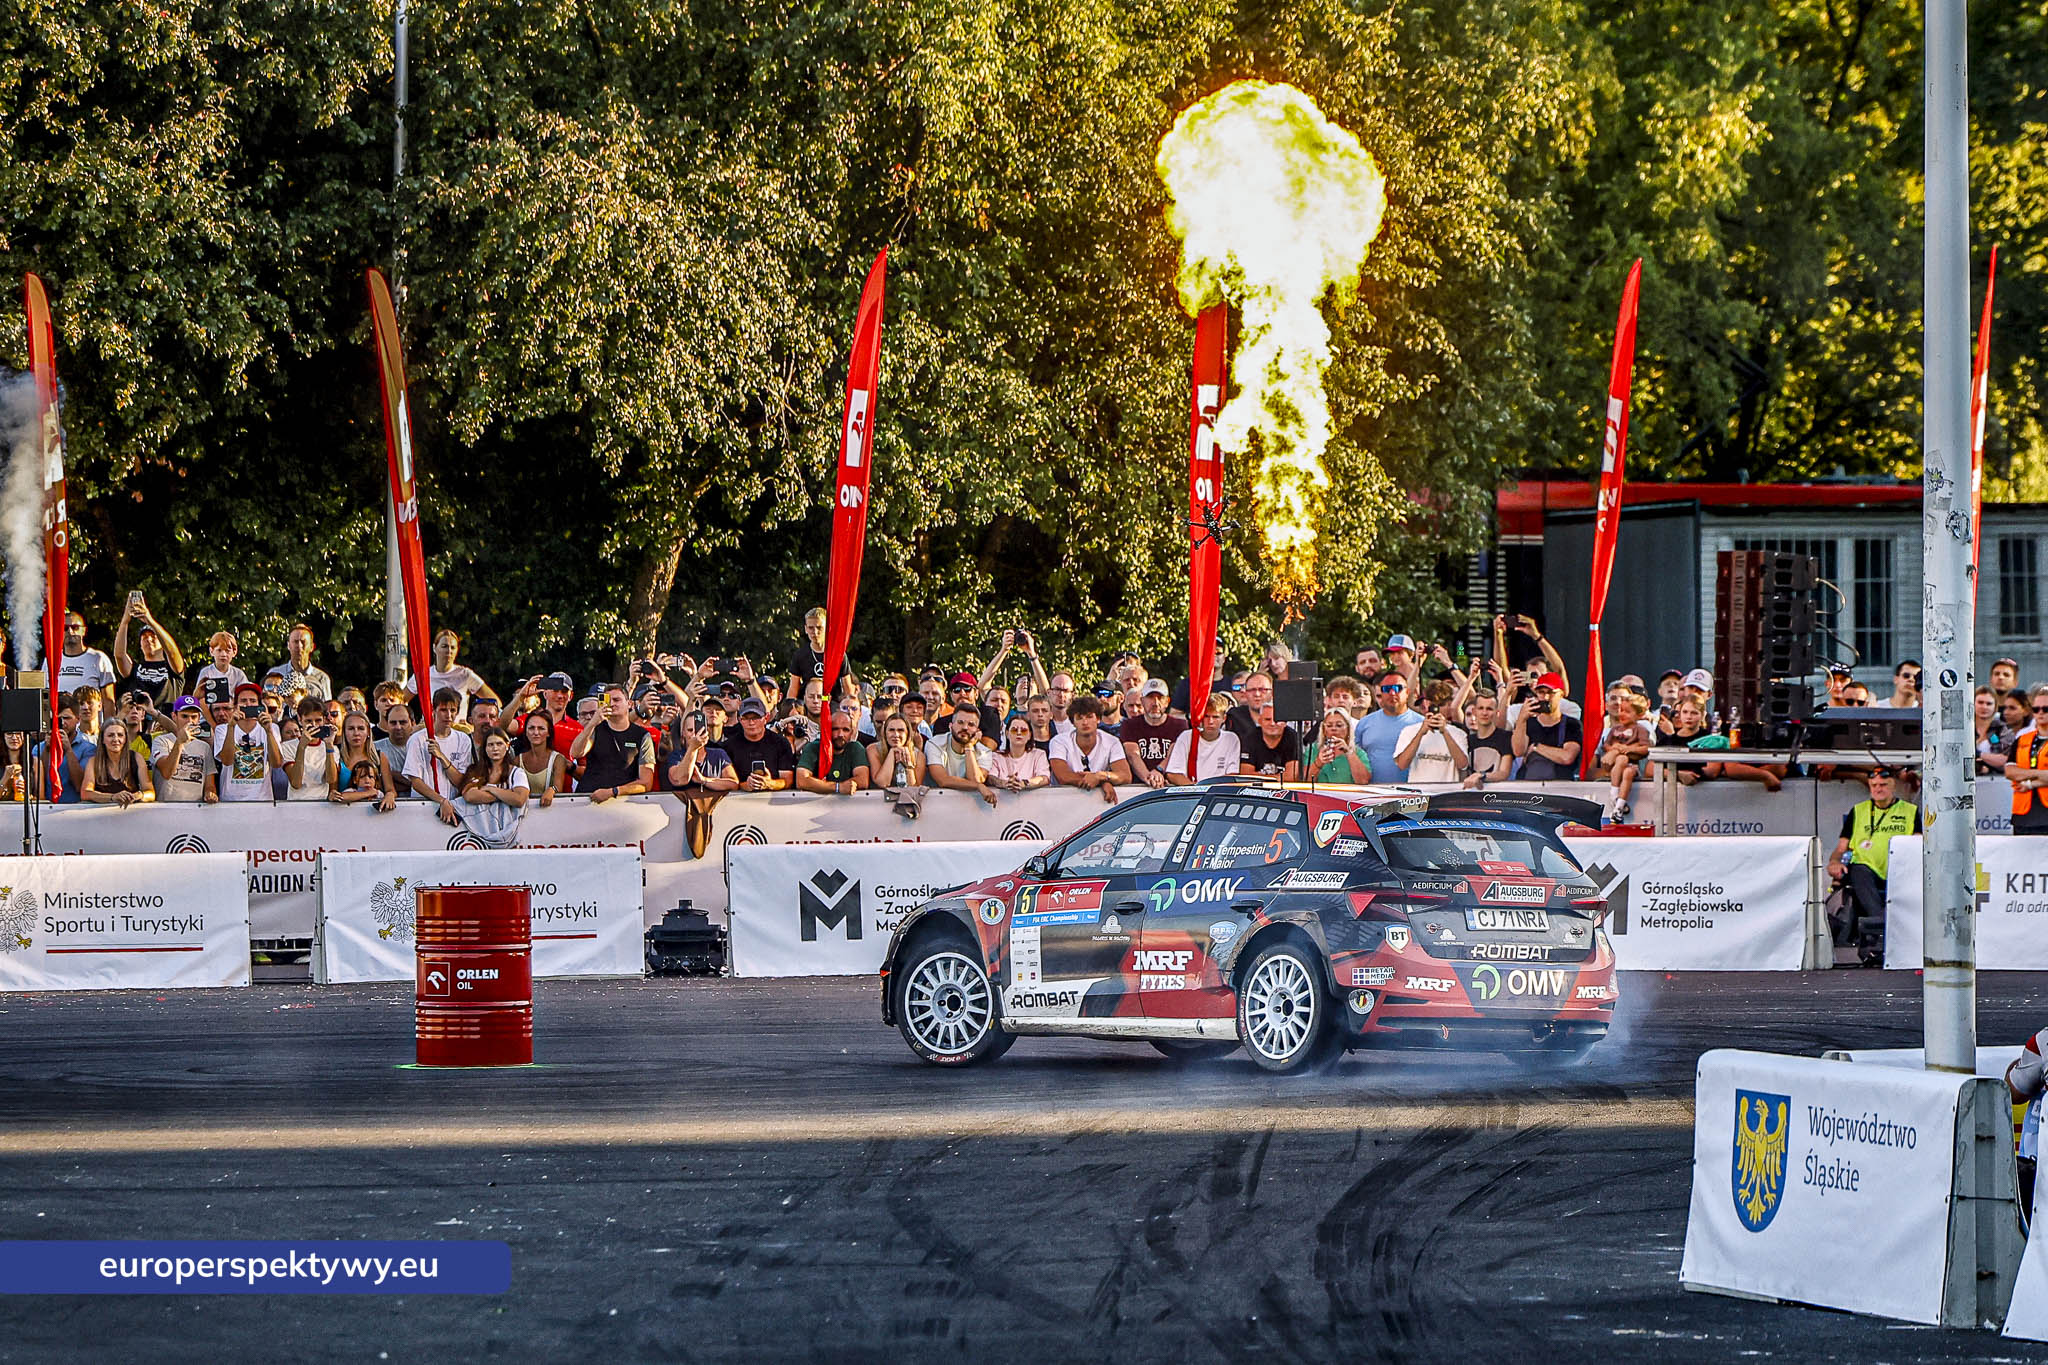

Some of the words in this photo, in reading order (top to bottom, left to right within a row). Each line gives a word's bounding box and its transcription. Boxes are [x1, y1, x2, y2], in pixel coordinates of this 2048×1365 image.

[1321, 819, 1340, 831] BT
[1643, 819, 1764, 834] ewództwo
[1207, 845, 1215, 855] S.
[1219, 844, 1266, 858] Tempestini
[1264, 829, 1288, 864] 5
[250, 873, 303, 894] ADION
[1291, 873, 1345, 883] AUGSBURG
[1412, 882, 1452, 890] AEDIFICIUM
[875, 884, 945, 898] Górnośl
[1181, 876, 1246, 904] OMV
[1500, 887, 1543, 897] AUGSBURG
[1566, 887, 1593, 895] AEDIFICIUM
[1642, 881, 1723, 898] Górnośląsko
[44, 892, 163, 908] Ministerstwo
[1021, 887, 1035, 913] 5
[2006, 900, 2024, 912] dla
[531, 901, 597, 922] urystyki
[44, 916, 105, 936] Sportu
[111, 915, 115, 932] i
[121, 914, 204, 936] Turystyki
[1641, 916, 1714, 933] Metropolia
[1391, 932, 1406, 940] BT
[1471, 944, 1553, 959] ROMBAT
[1132, 951, 1193, 971] MRF
[456, 968, 499, 980] ORLEN
[1141, 974, 1185, 990] TYRES
[457, 981, 473, 990] OIL
[1405, 976, 1456, 992] MRF
[1507, 969, 1564, 996] OMV
[1011, 991, 1078, 1009] ROMBAT
[1807, 1105, 1917, 1150] Województwo
[1803, 1149, 1859, 1196] Śląskie
